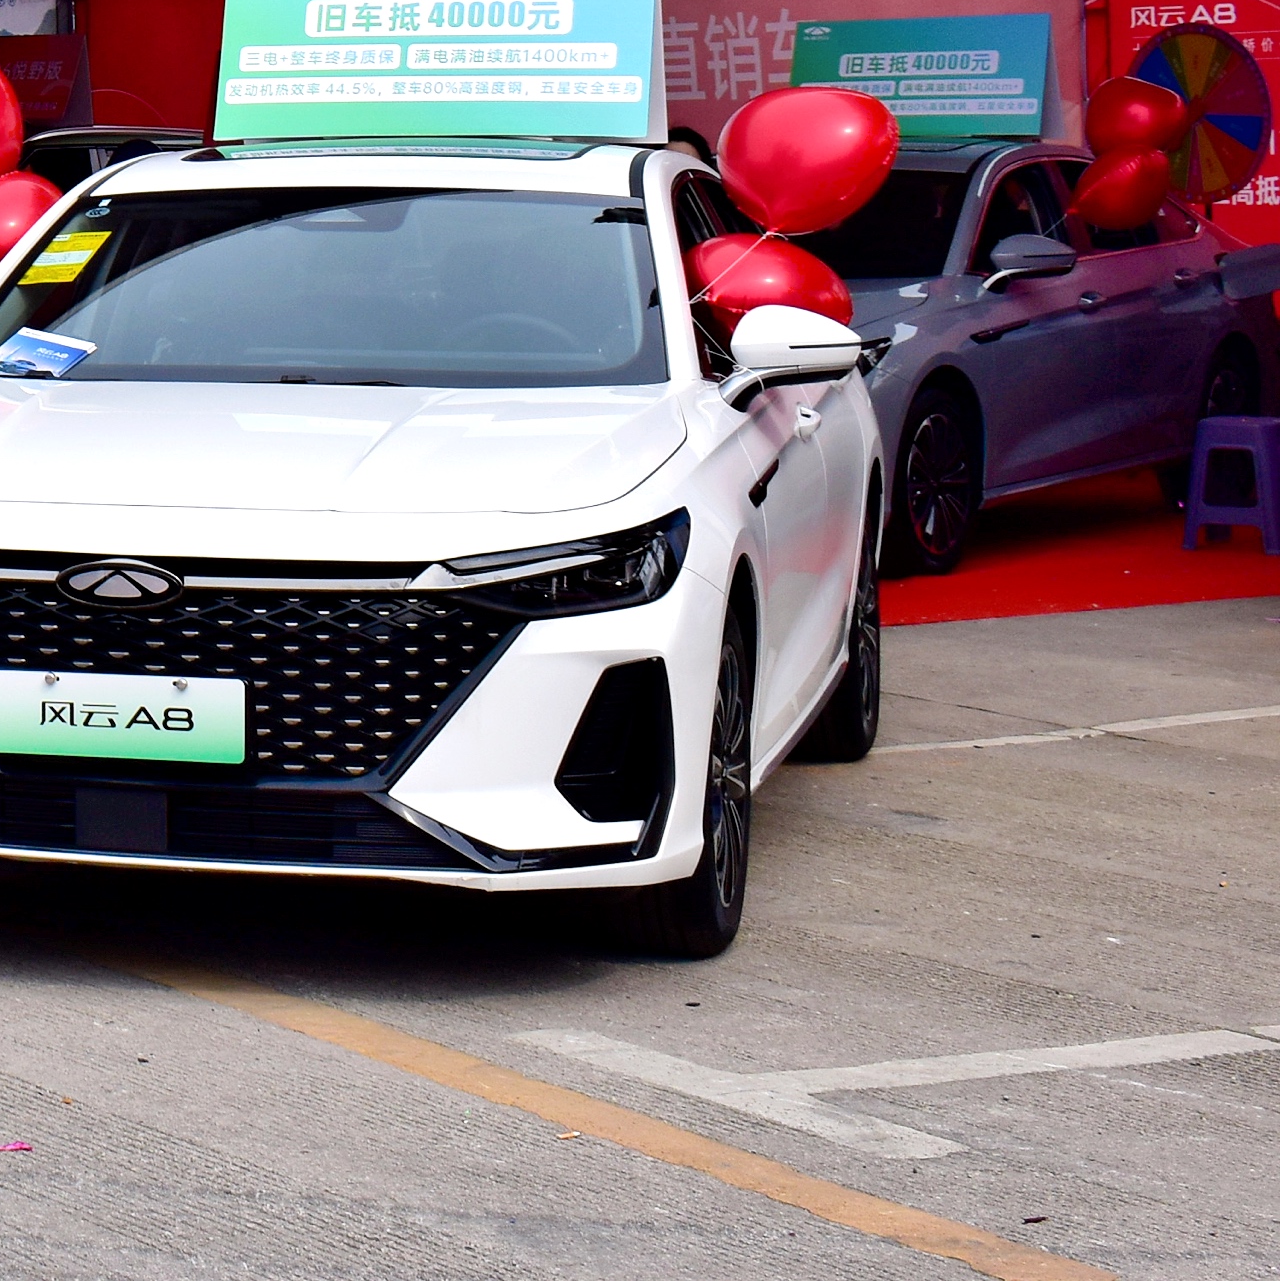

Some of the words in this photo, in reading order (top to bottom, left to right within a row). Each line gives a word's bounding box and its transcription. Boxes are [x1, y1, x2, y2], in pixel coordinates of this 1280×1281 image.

[245, 49, 395, 67] 三电+整车终身质保
